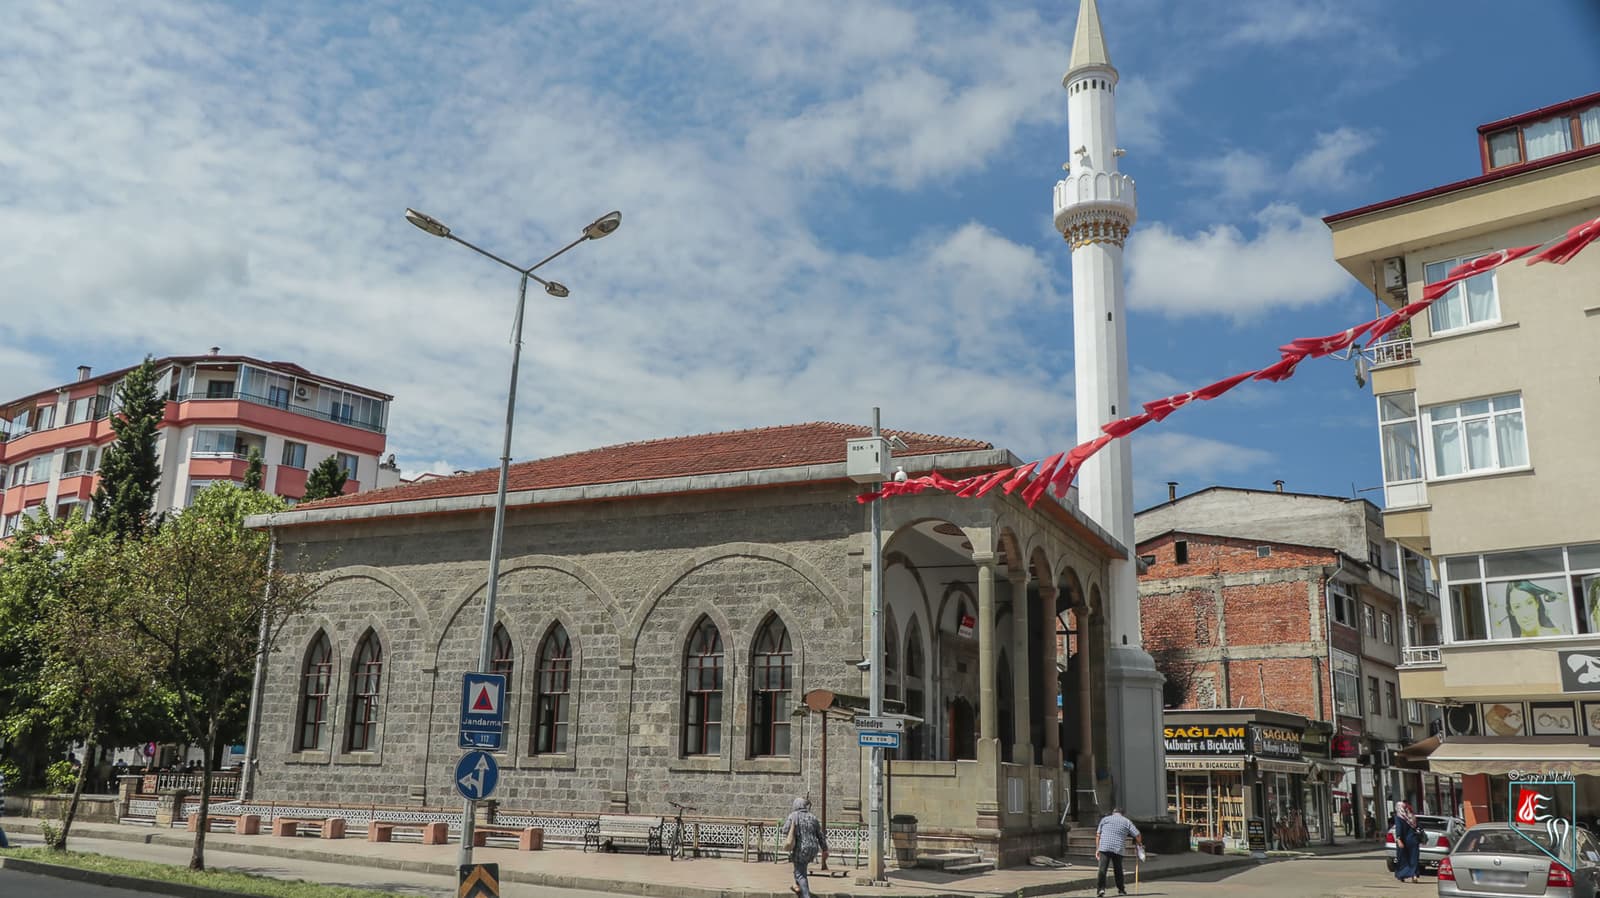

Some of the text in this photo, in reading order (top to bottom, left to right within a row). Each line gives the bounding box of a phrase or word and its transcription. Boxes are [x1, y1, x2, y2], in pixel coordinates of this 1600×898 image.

[464, 718, 501, 726] Jandarma
[856, 719, 883, 728] Belediye
[1164, 726, 1245, 738] SAĞLAM
[1200, 740, 1206, 750] &
